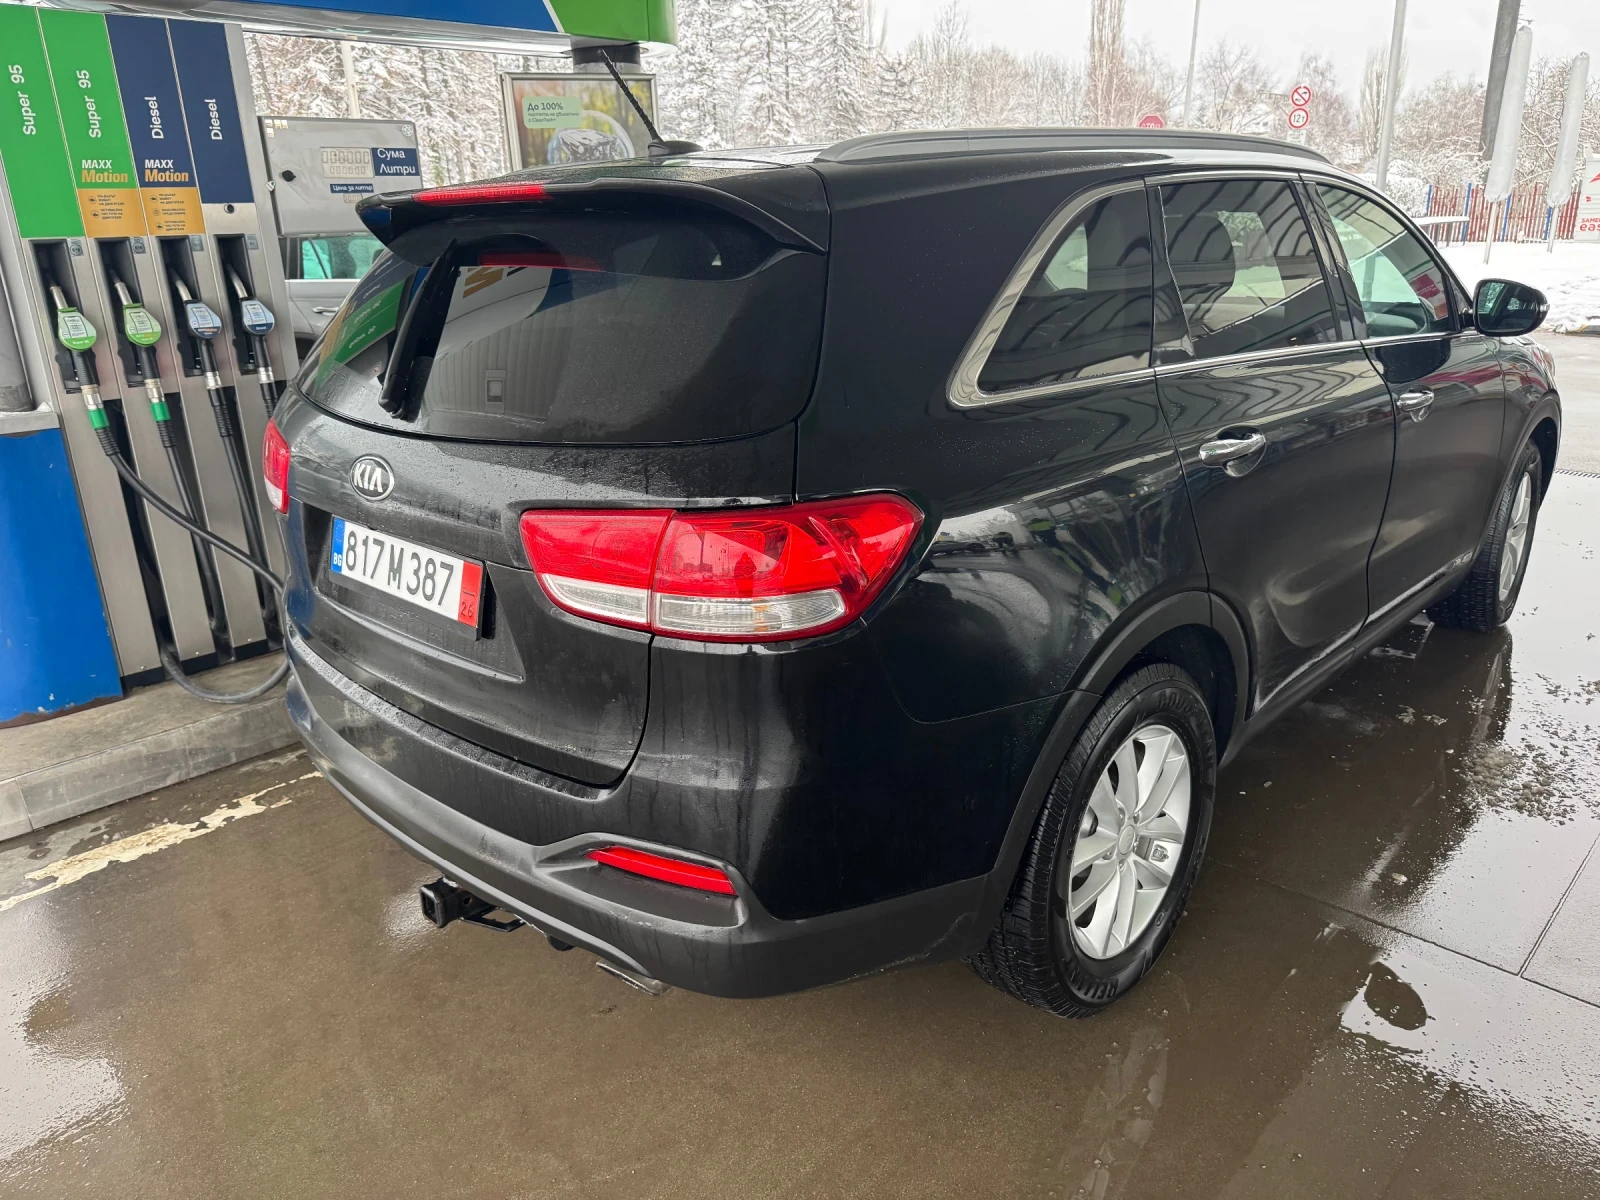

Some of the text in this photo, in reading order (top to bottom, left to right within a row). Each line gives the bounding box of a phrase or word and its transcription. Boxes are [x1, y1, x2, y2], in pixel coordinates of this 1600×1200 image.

[8, 64, 36, 135] Super 95
[76, 69, 102, 138] Super 95
[527, 102, 564, 112] До 100%
[144, 96, 164, 139] Diesel
[204, 98, 223, 140] Diesel
[377, 148, 406, 161] Сума
[81, 159, 113, 169] MAXX
[144, 159, 174, 169] MAXX
[379, 163, 416, 176] Литри
[81, 169, 129, 183] Motion
[144, 169, 189, 183] Motion
[332, 184, 347, 192] Цена
[354, 462, 383, 493] KIA
[333, 552, 342, 567] BG
[460, 600, 474, 619] 26
